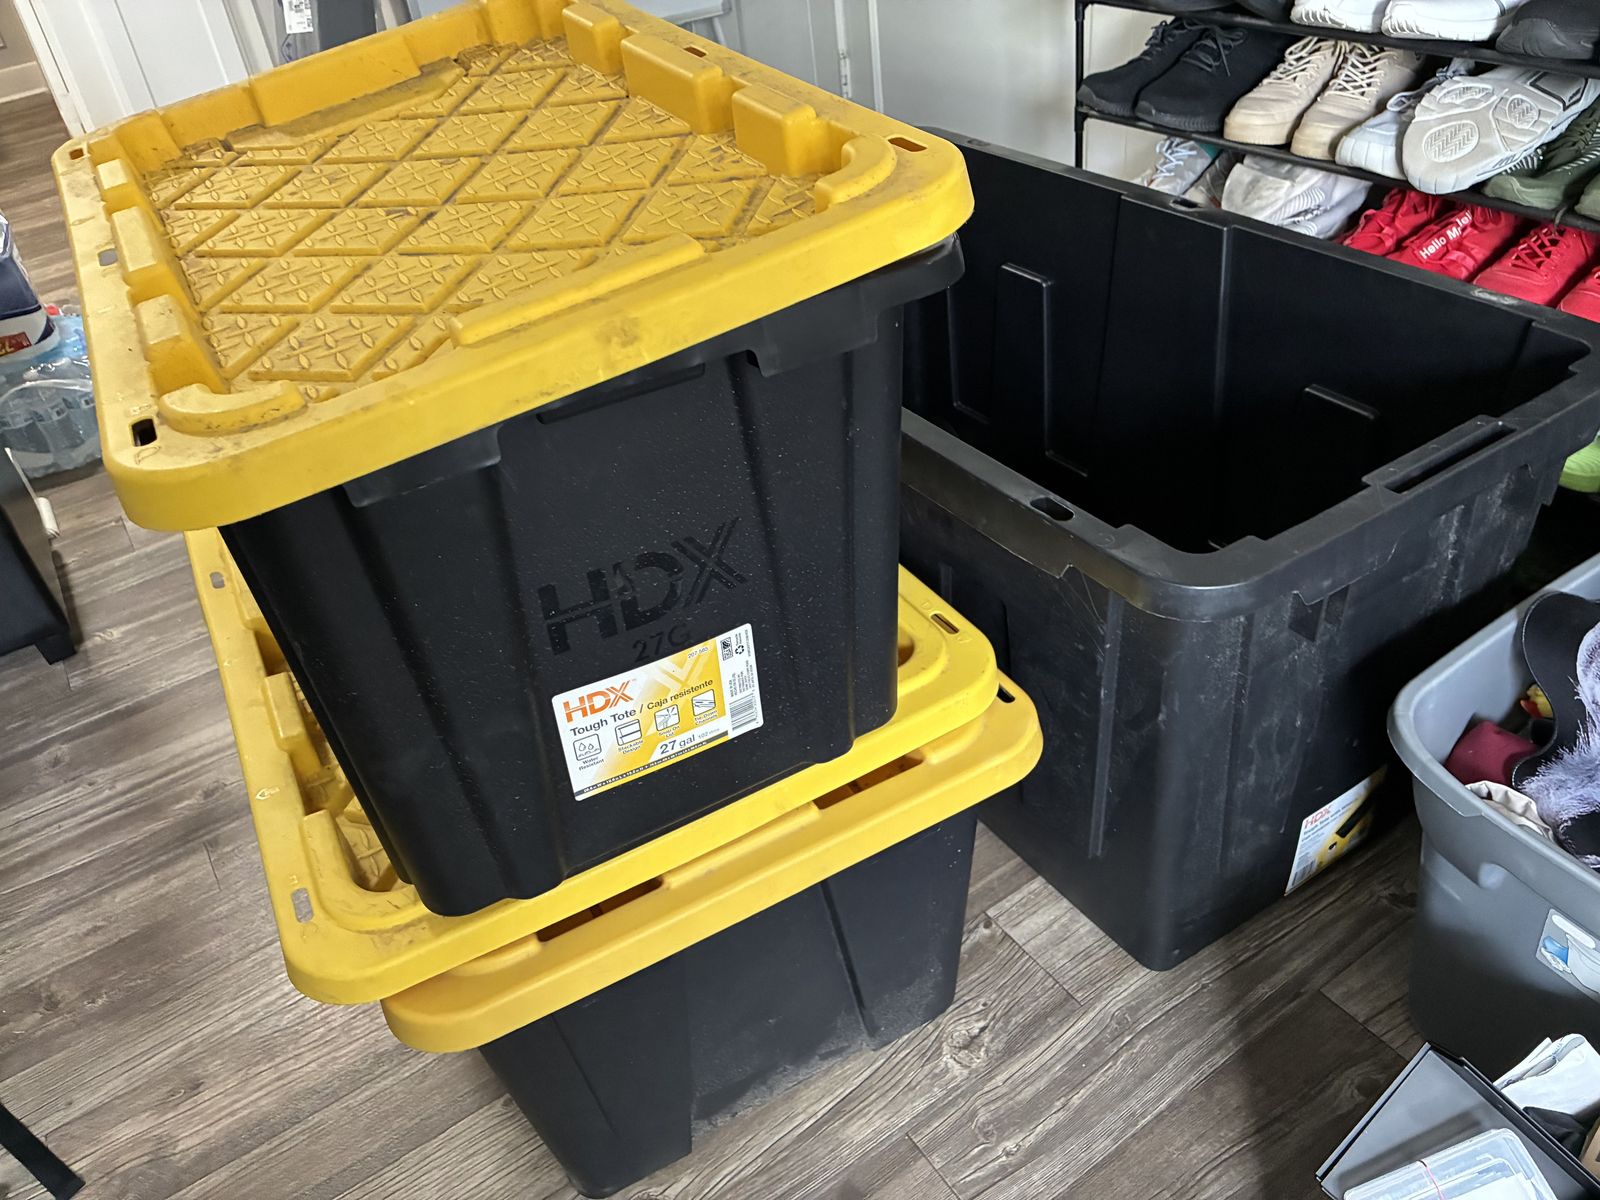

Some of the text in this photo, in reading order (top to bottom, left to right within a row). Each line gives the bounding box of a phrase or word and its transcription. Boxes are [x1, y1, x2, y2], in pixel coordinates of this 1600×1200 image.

[1419, 236, 1447, 260] Hello
[537, 516, 748, 656] HDX
[563, 680, 634, 723] HDX
[570, 718, 608, 737] Tough
[610, 708, 637, 723] Tote
[646, 696, 669, 711] Caja
[670, 679, 714, 702] resistente
[660, 740, 677, 755] 27
[679, 734, 696, 749] gal
[1304, 804, 1332, 829] HDX
